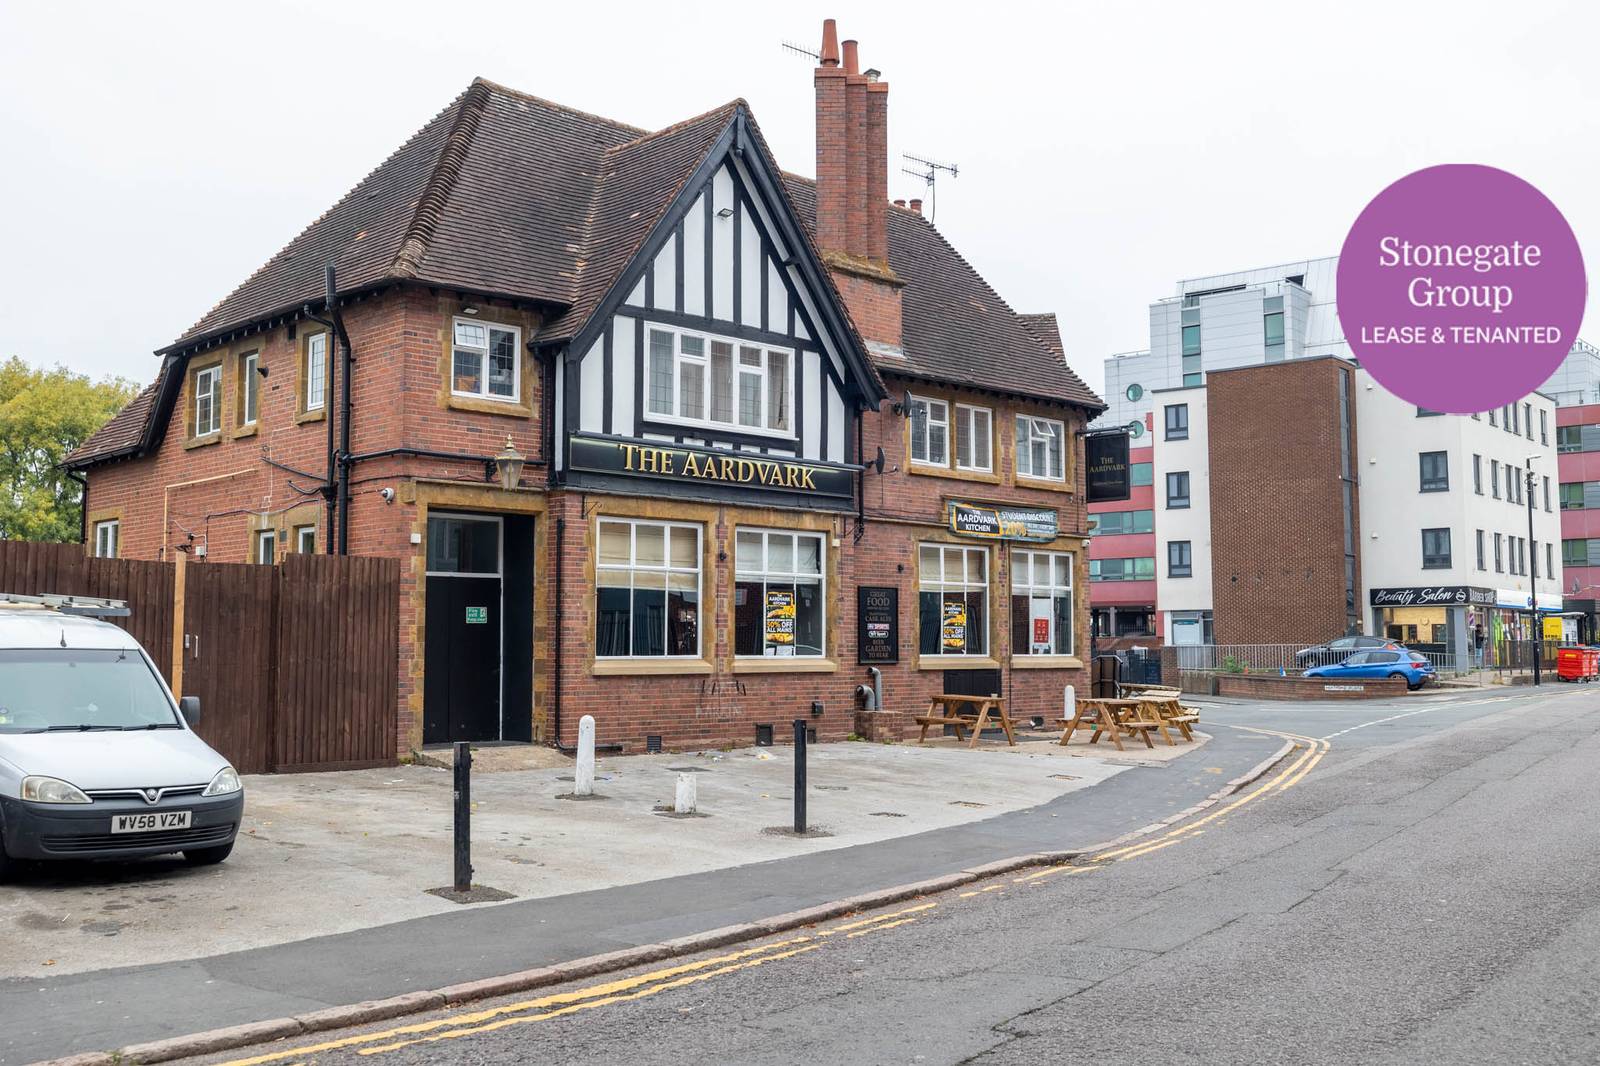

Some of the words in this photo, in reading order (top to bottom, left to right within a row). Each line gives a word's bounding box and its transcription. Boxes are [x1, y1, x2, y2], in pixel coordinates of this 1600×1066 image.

[618, 443, 674, 474] THE
[681, 452, 817, 490] AARDVARK
[1100, 457, 1114, 465] THE
[1089, 464, 1126, 473] AARDVARK
[957, 513, 998, 525] AARDVARK
[965, 524, 991, 532] KITCHEN
[1374, 589, 1417, 606] Beauty
[1416, 587, 1455, 604] Salon
[1469, 588, 1484, 602] BARBER
[867, 597, 890, 606] FOOD
[119, 815, 156, 830] WV58
[160, 813, 186, 827] VZM
